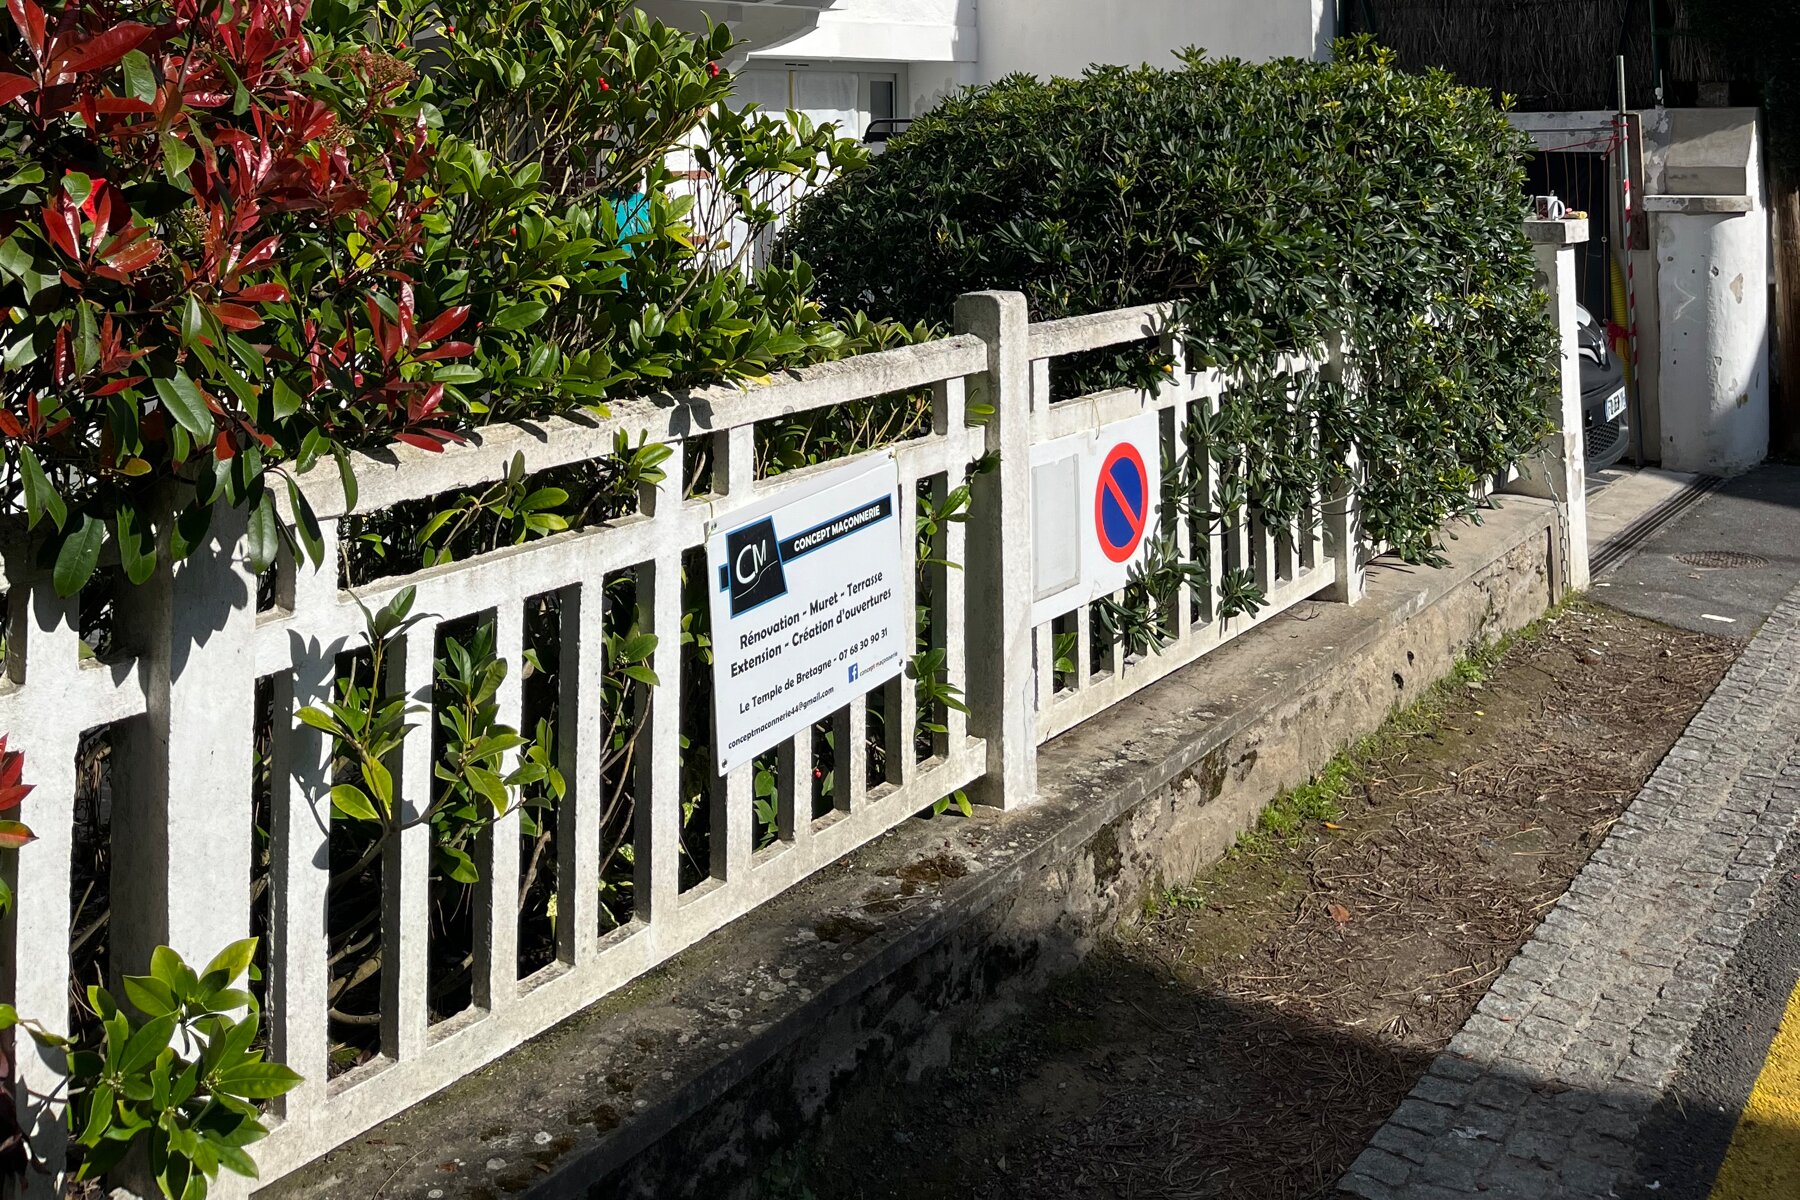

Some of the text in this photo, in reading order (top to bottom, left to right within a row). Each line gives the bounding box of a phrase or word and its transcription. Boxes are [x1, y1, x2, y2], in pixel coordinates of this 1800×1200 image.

[736, 539, 767, 584] CM
[794, 505, 880, 551] CONCEPT MAÇONNERIE
[731, 644, 782, 678] Extension
[792, 618, 834, 646] Création
[836, 588, 891, 624] d'ouvertures
[740, 613, 800, 649] Rénovation
[810, 592, 838, 616] Muret
[847, 572, 883, 596] Terrasse
[740, 702, 750, 714] Le
[752, 684, 782, 707] Temple
[784, 677, 794, 690] de
[796, 659, 832, 684] Bretagne
[838, 649, 848, 661] 07
[849, 644, 859, 655] 68
[860, 638, 869, 650] 30
[870, 632, 880, 644] 90
[881, 627, 888, 639] 31
